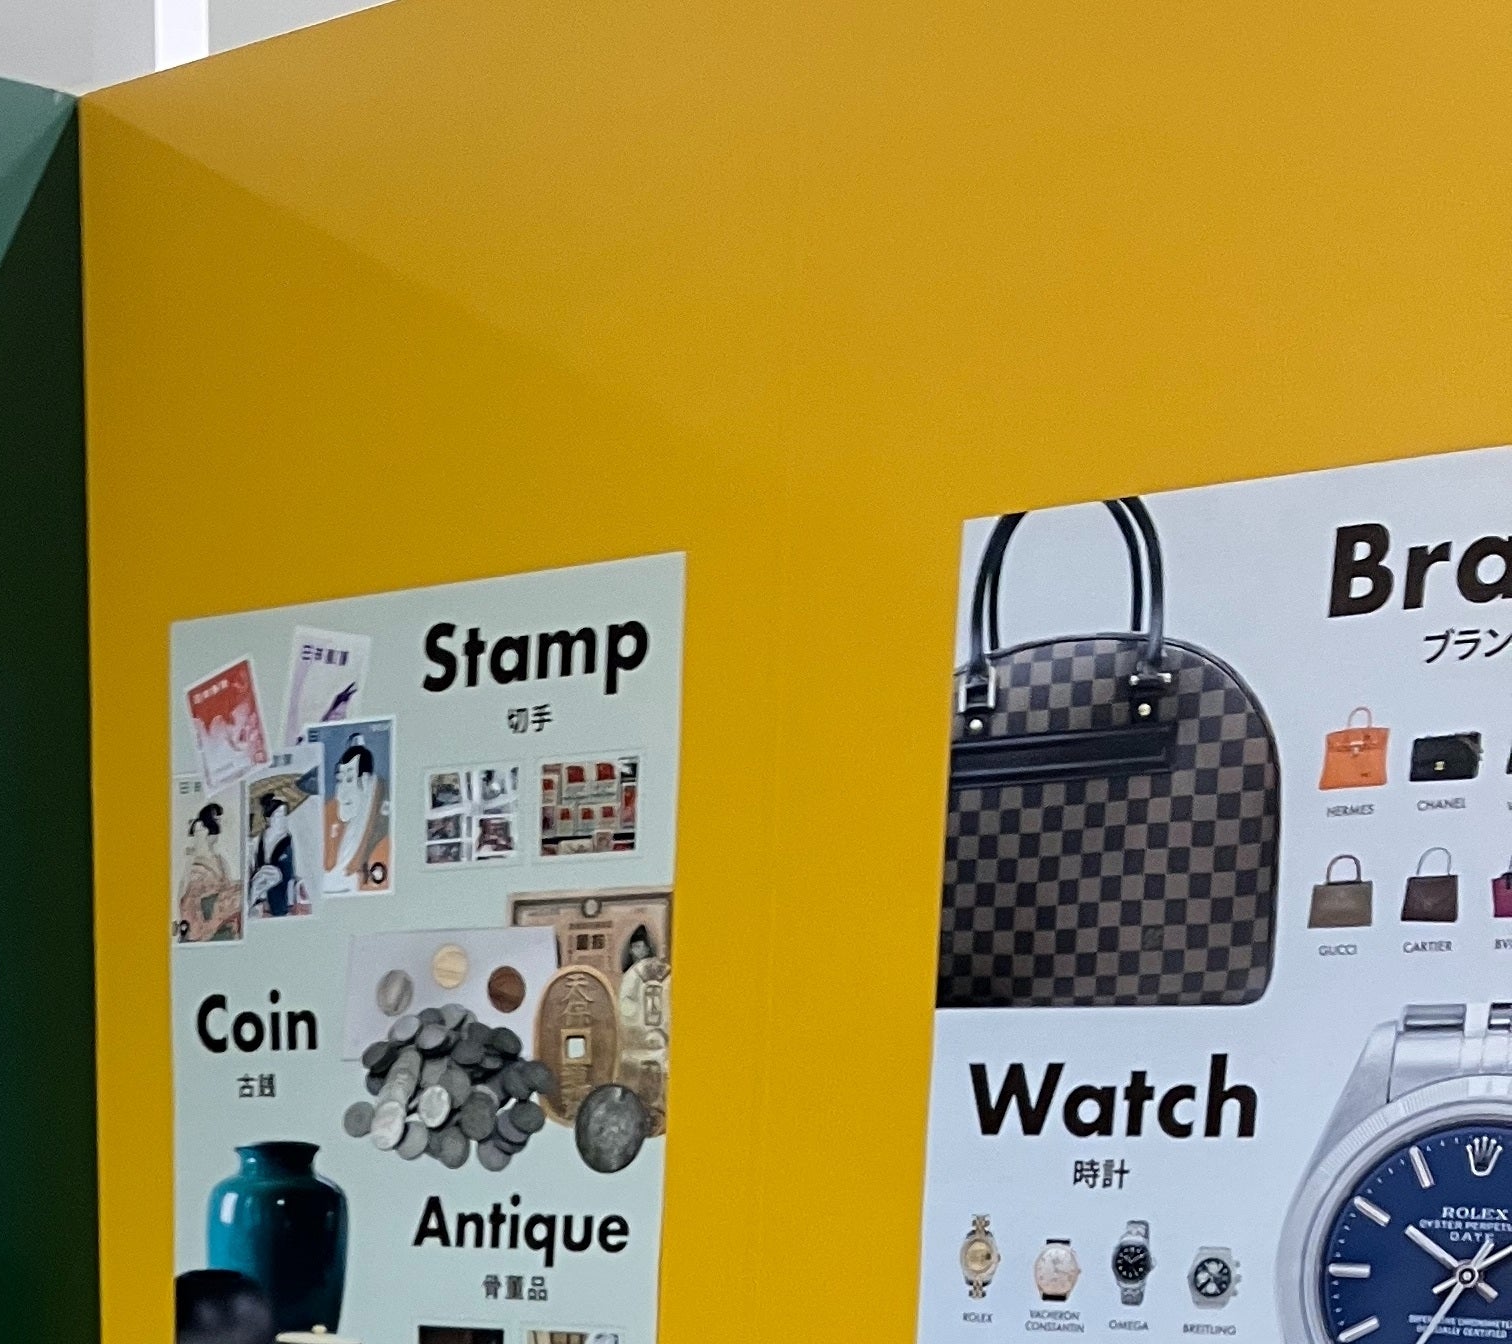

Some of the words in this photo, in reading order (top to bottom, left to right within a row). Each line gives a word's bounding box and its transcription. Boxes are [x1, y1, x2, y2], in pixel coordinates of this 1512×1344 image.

[1328, 523, 1512, 618] Bra
[422, 620, 648, 695] Stamp
[508, 704, 553, 734] 切手
[1327, 804, 1375, 817] HERMES
[1417, 798, 1466, 811] CHANEL
[1319, 944, 1357, 956] GUCCI
[1403, 941, 1452, 953] CARTIER
[197, 989, 318, 1053] Coin
[969, 1053, 1258, 1138] Watch
[1073, 1158, 1130, 1189] 時計
[1442, 1206, 1508, 1220] ROLEX
[413, 1194, 629, 1267] Antique
[1449, 1231, 1494, 1242] DATE
[483, 1274, 548, 1300] 骨董品
[962, 1312, 993, 1323] ROLEX
[1025, 1320, 1085, 1333] CONSTANTIN
[1108, 1320, 1149, 1331] OMEGA
[1183, 1323, 1237, 1336] BREITLING
